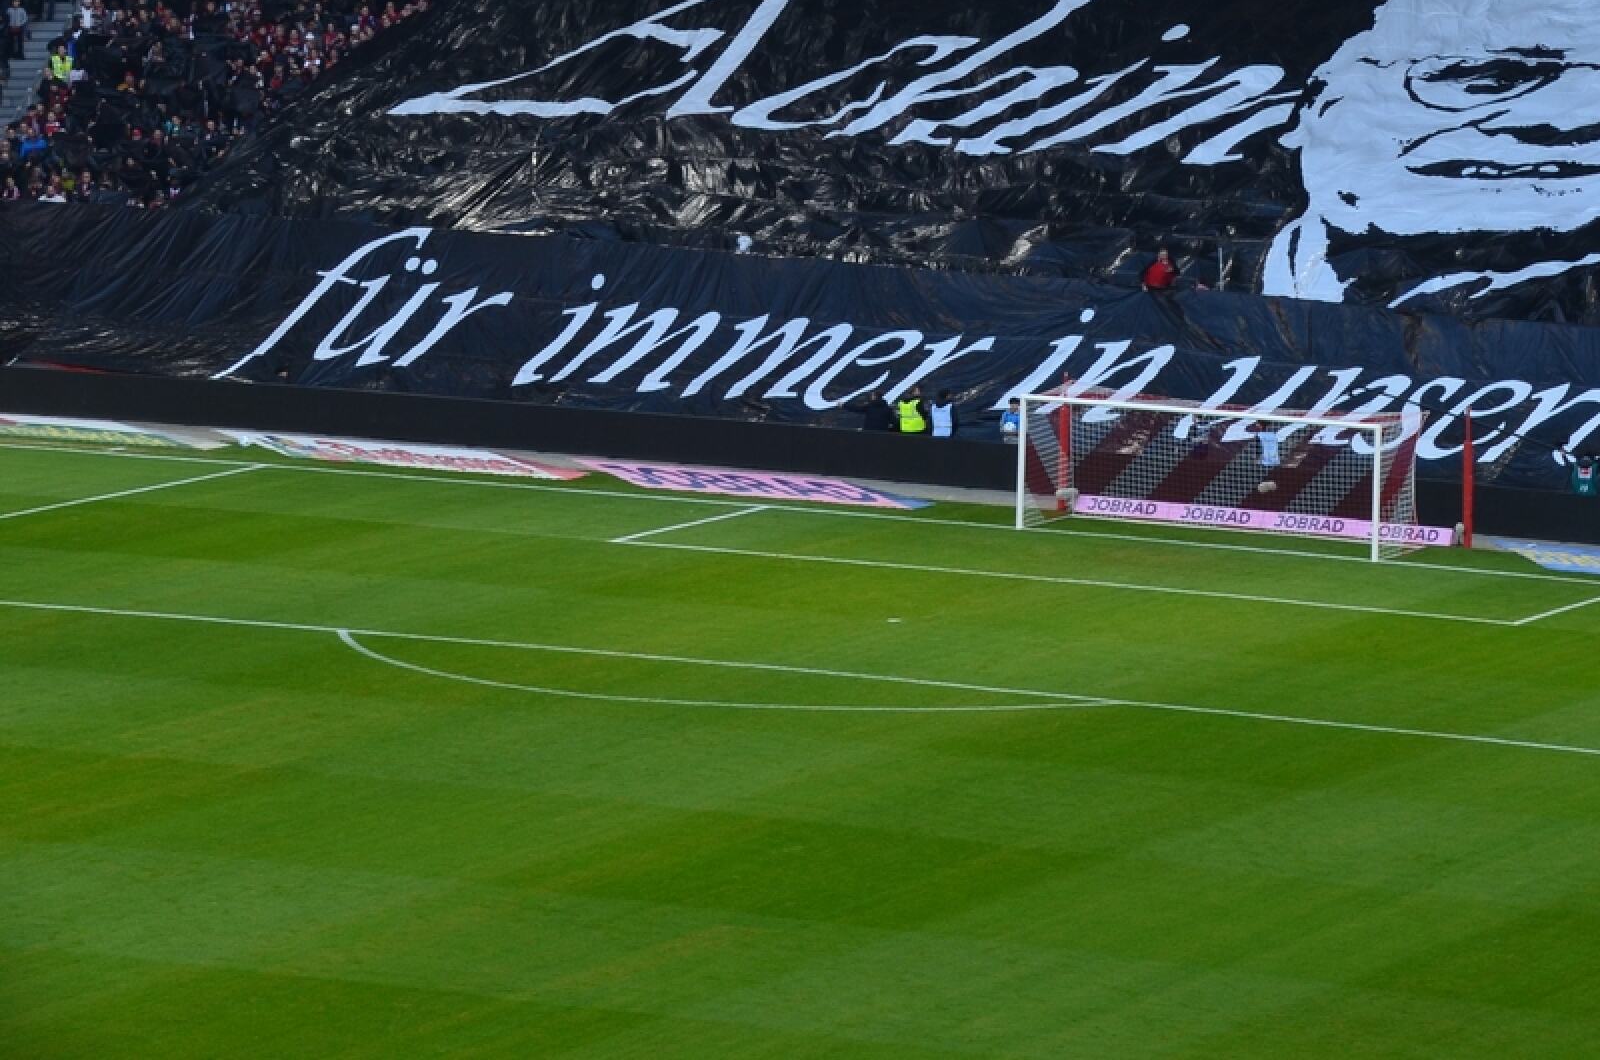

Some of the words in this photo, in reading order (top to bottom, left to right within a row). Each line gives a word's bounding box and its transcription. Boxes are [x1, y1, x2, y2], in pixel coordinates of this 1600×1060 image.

[209, 226, 513, 379] für
[511, 273, 997, 411] immer
[988, 309, 1175, 424] in
[1087, 496, 1159, 517] JOBRAD
[1180, 505, 1252, 526] JOBRAD
[1273, 515, 1345, 535] JOBRAD
